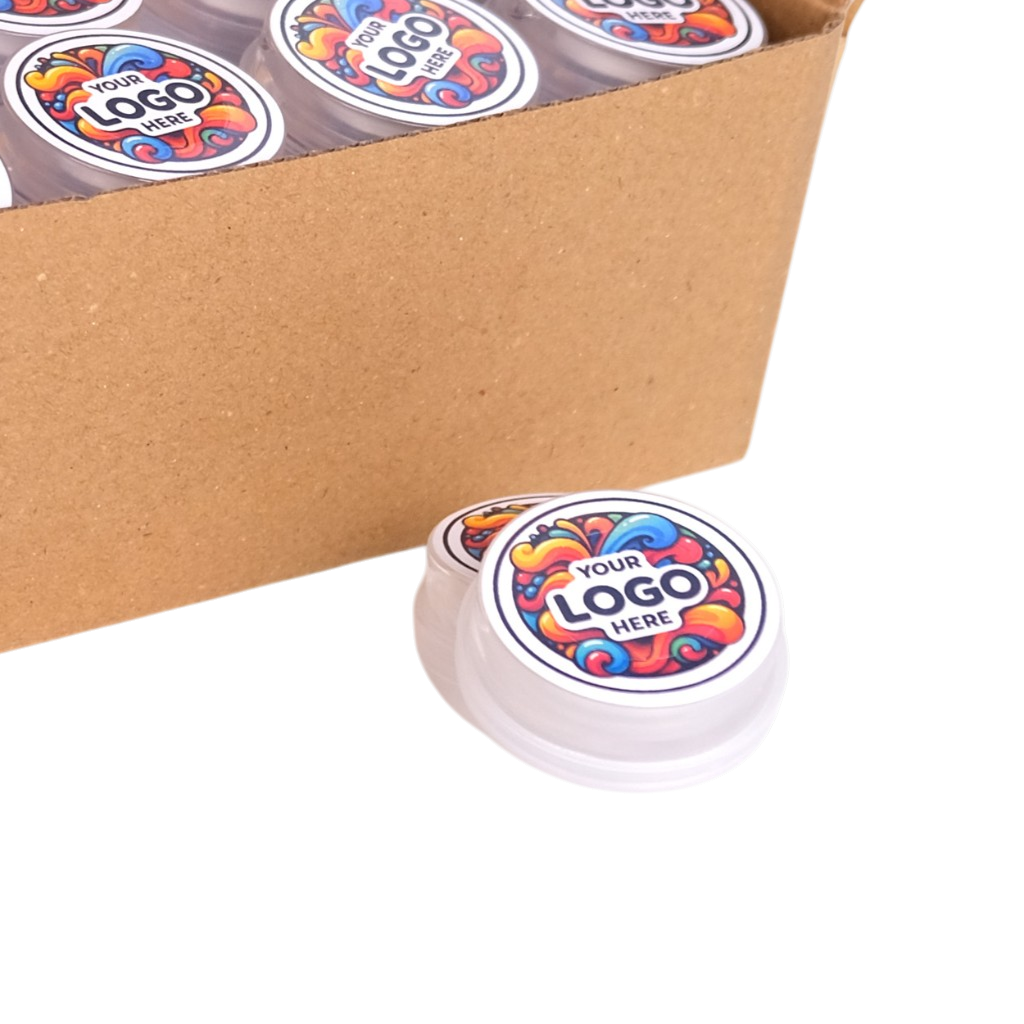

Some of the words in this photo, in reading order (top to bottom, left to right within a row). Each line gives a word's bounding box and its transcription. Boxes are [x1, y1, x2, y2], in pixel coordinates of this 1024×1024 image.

[626, 11, 676, 20] HERE
[352, 21, 386, 48] YOUR
[366, 16, 442, 81] LOGO
[421, 47, 453, 75] HERE
[88, 74, 144, 94] YOUR
[80, 82, 204, 126] LOGO
[141, 112, 193, 132] HERE
[576, 555, 642, 578] YOUR
[553, 569, 701, 623] LOGO
[611, 610, 673, 635] HERE
